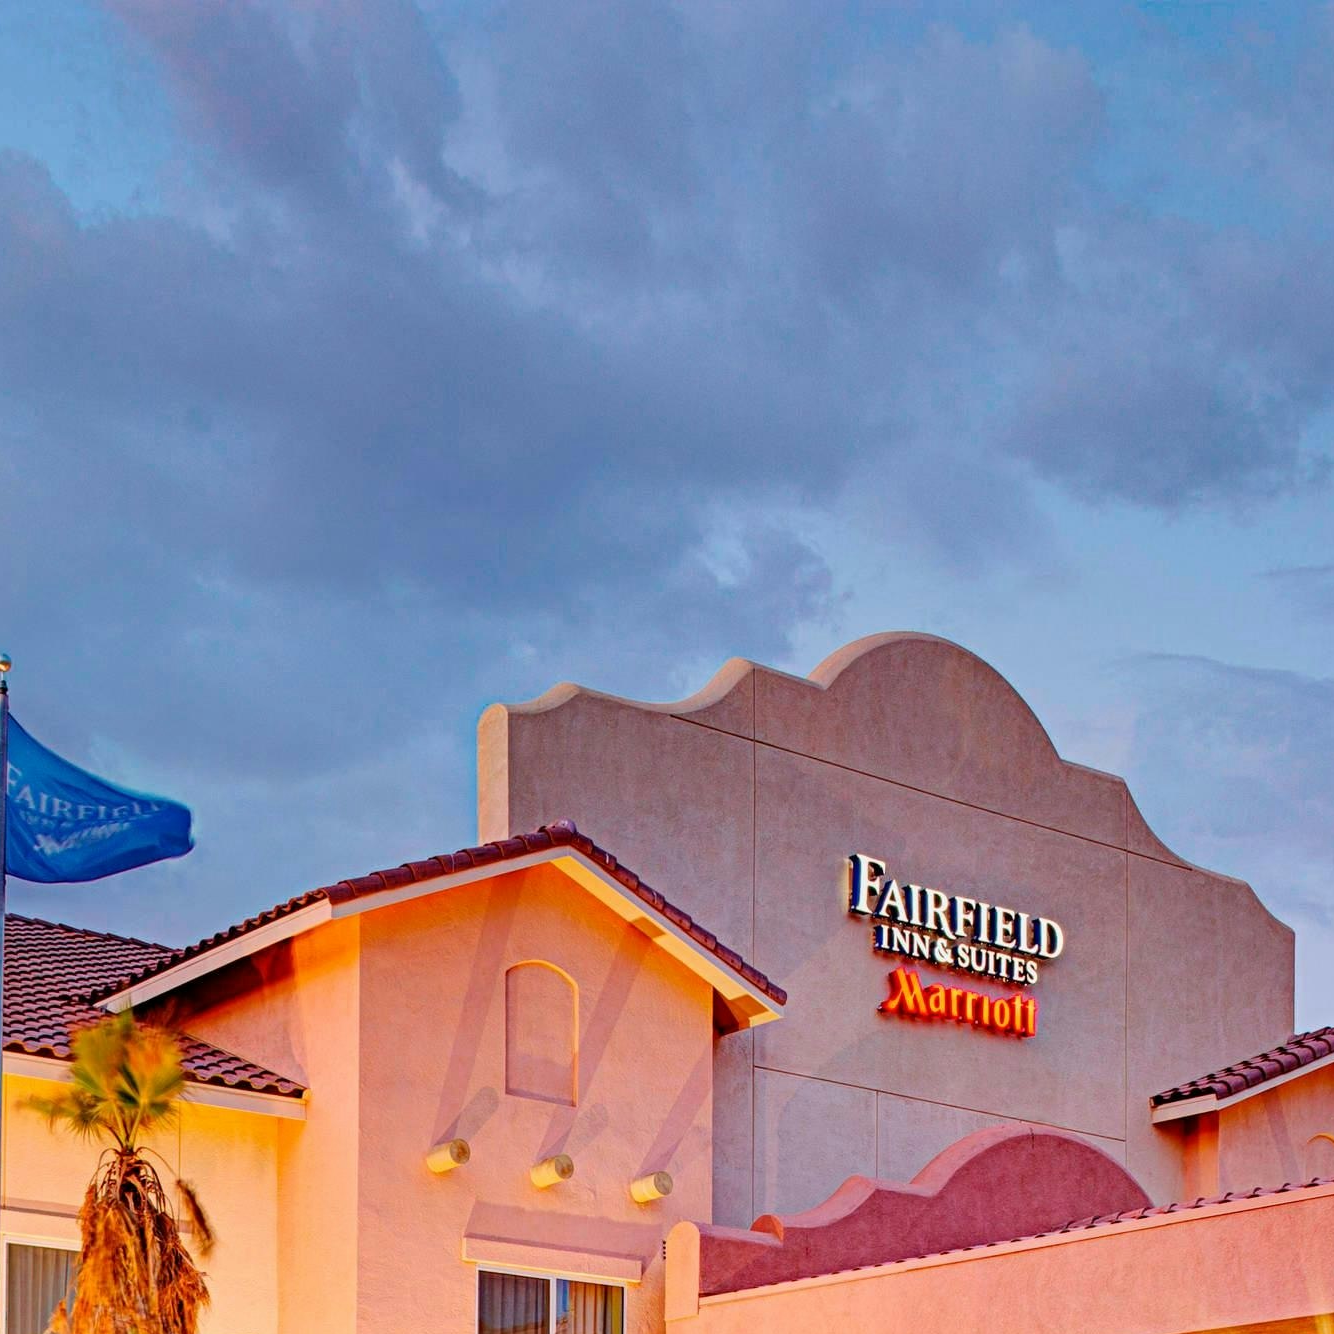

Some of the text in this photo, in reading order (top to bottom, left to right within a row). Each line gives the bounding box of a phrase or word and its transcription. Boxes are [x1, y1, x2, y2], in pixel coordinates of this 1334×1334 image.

[849, 853, 1064, 959] FAIRFIELD
[876, 924, 1038, 985] INN & SUITES
[880, 966, 1038, 1037] Marriott
